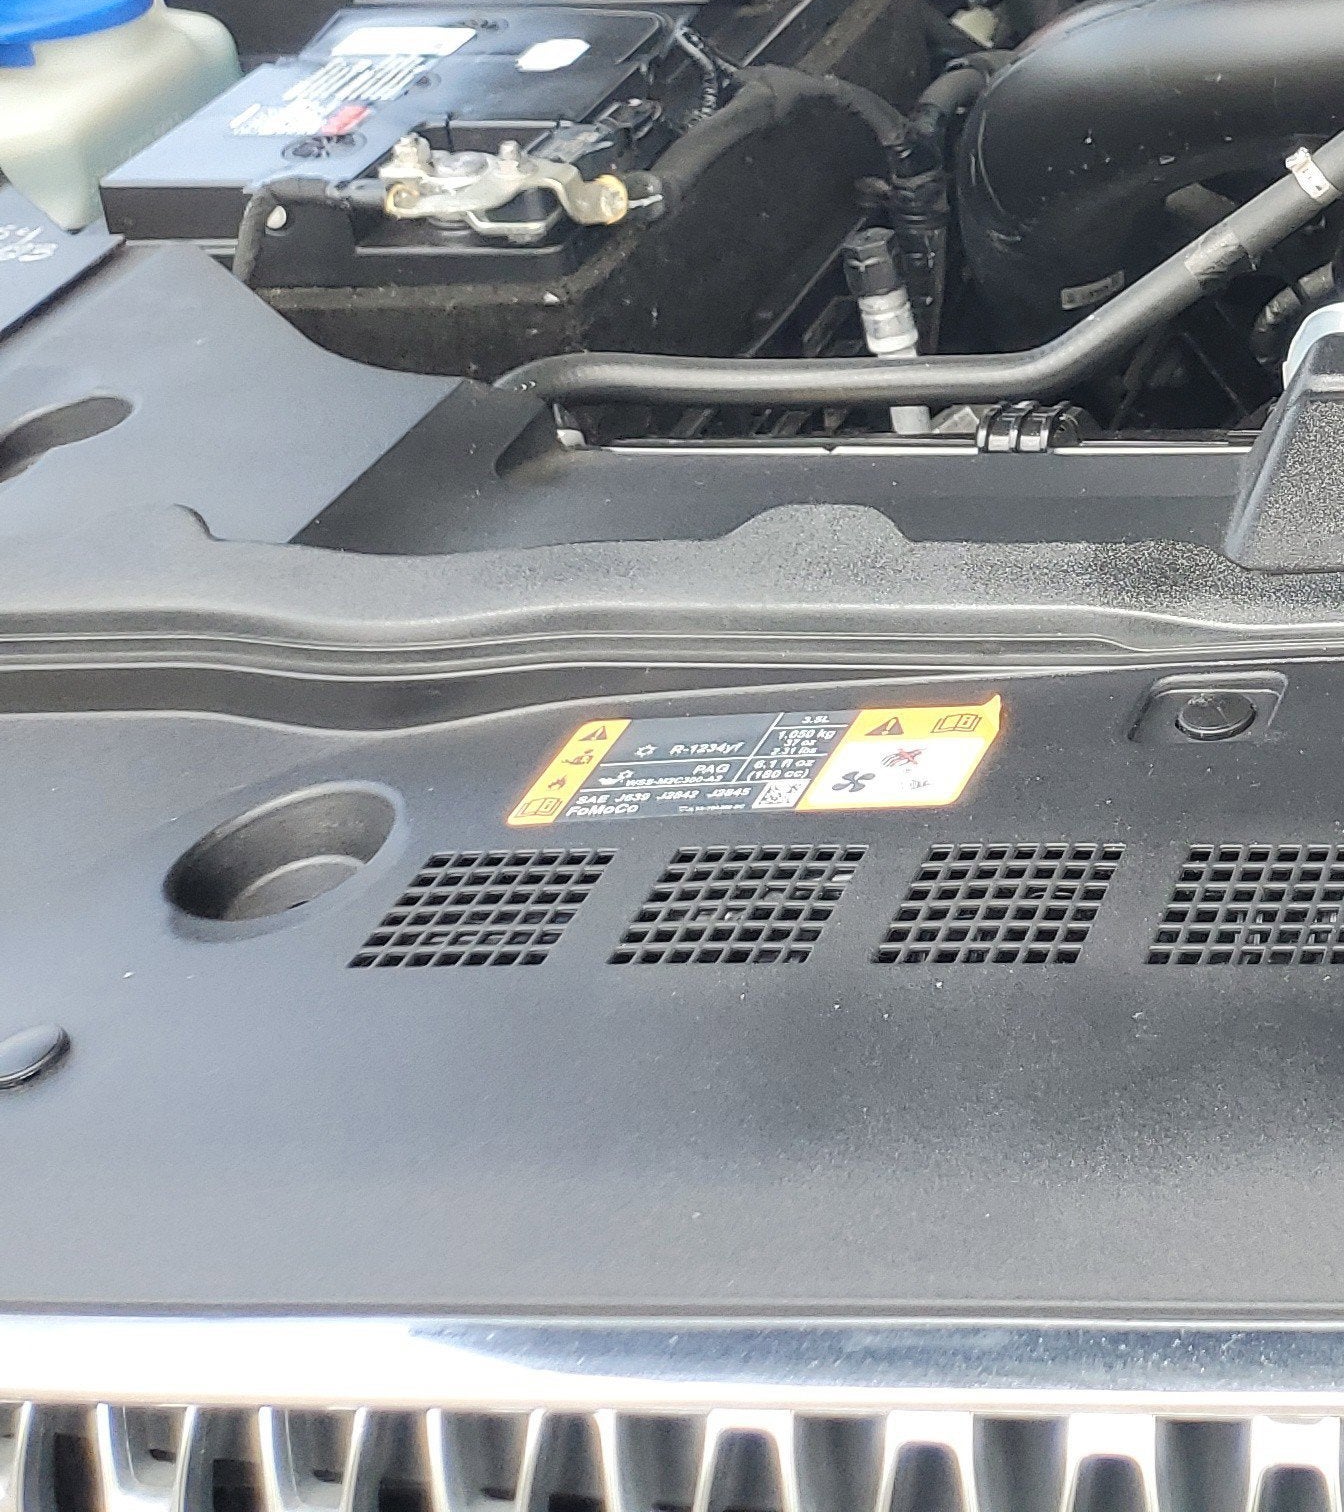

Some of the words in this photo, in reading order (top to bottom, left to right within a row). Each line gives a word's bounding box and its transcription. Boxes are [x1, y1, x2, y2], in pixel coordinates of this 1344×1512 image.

[801, 715, 830, 724] 3.5L
[817, 729, 837, 740] kg
[669, 741, 745, 756] R-1234yf
[783, 739, 800, 747] 37
[692, 763, 731, 775] PAG
[780, 759, 794, 768] fl
[795, 759, 816, 767] oz
[746, 770, 782, 781] (180
[784, 769, 810, 779] cc)
[576, 794, 610, 805] SAE
[615, 792, 651, 803] J639
[565, 803, 640, 817] FoMoCo
